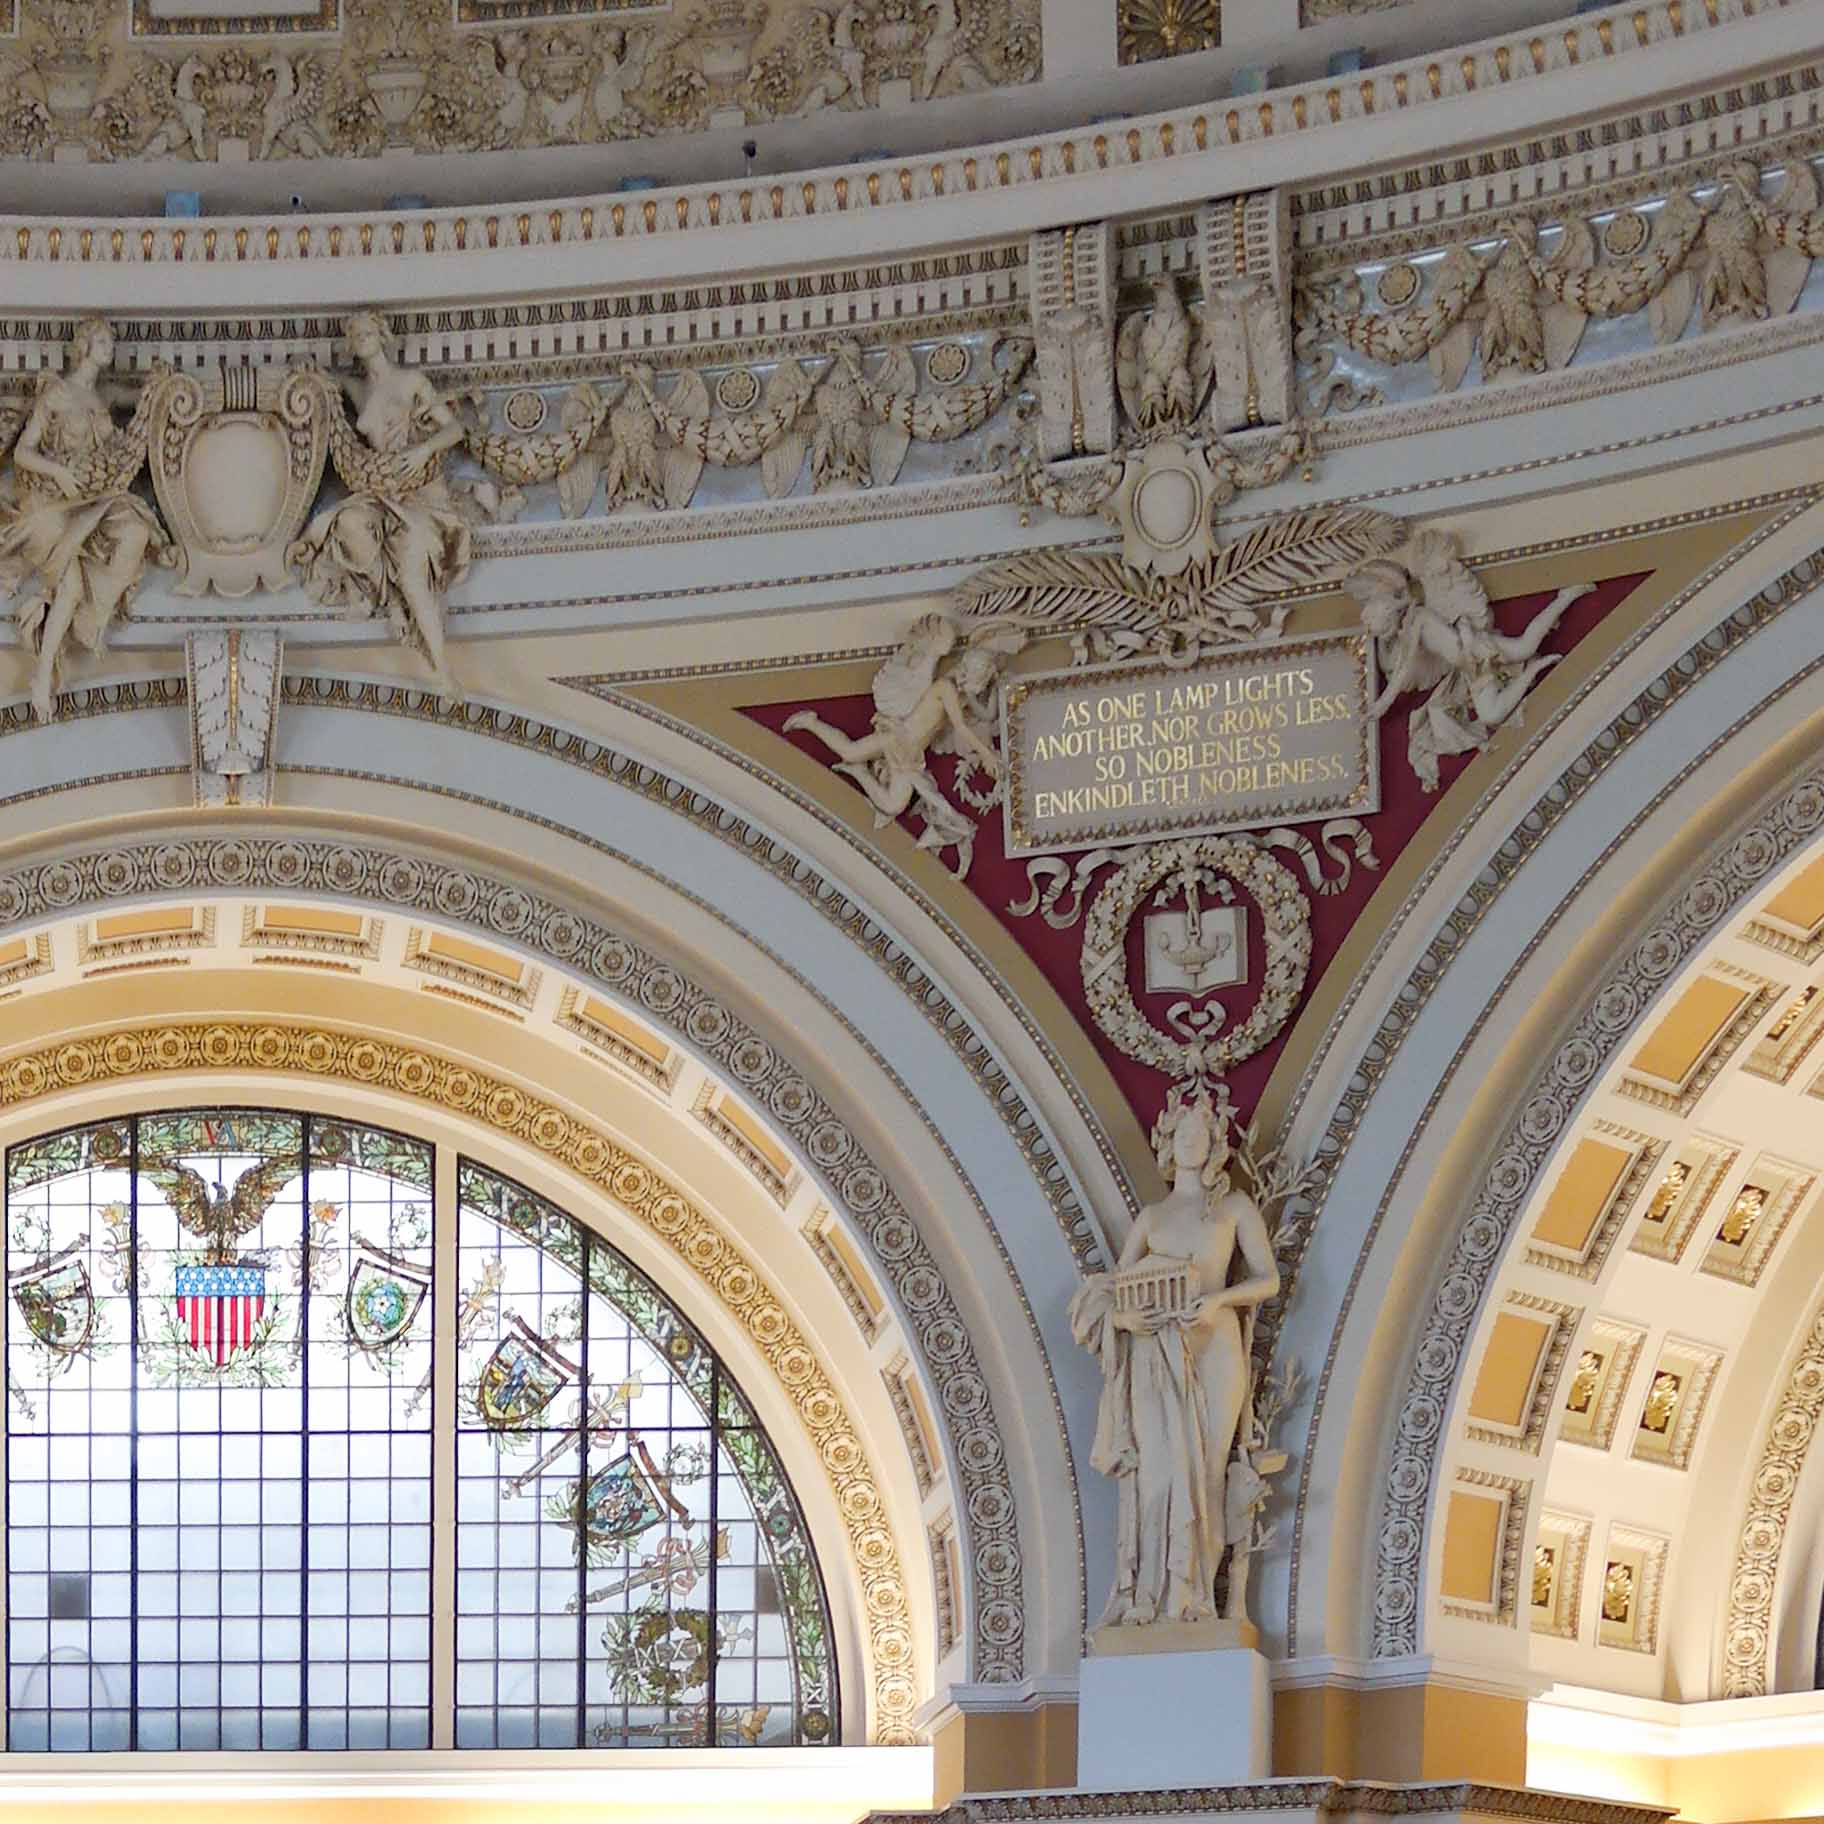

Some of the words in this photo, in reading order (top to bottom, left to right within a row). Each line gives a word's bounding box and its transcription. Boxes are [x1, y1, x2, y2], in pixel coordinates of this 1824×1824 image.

[1062, 701, 1091, 729] AS
[1097, 693, 1147, 722] ONE
[1155, 683, 1218, 715] LAMP
[1225, 669, 1314, 705] LIGHTS
[1207, 703, 1288, 736] GROWS
[1095, 754, 1125, 782] SO
[1136, 734, 1280, 777] NOBLENESS
[1034, 774, 1189, 819] ENKINDLETH
